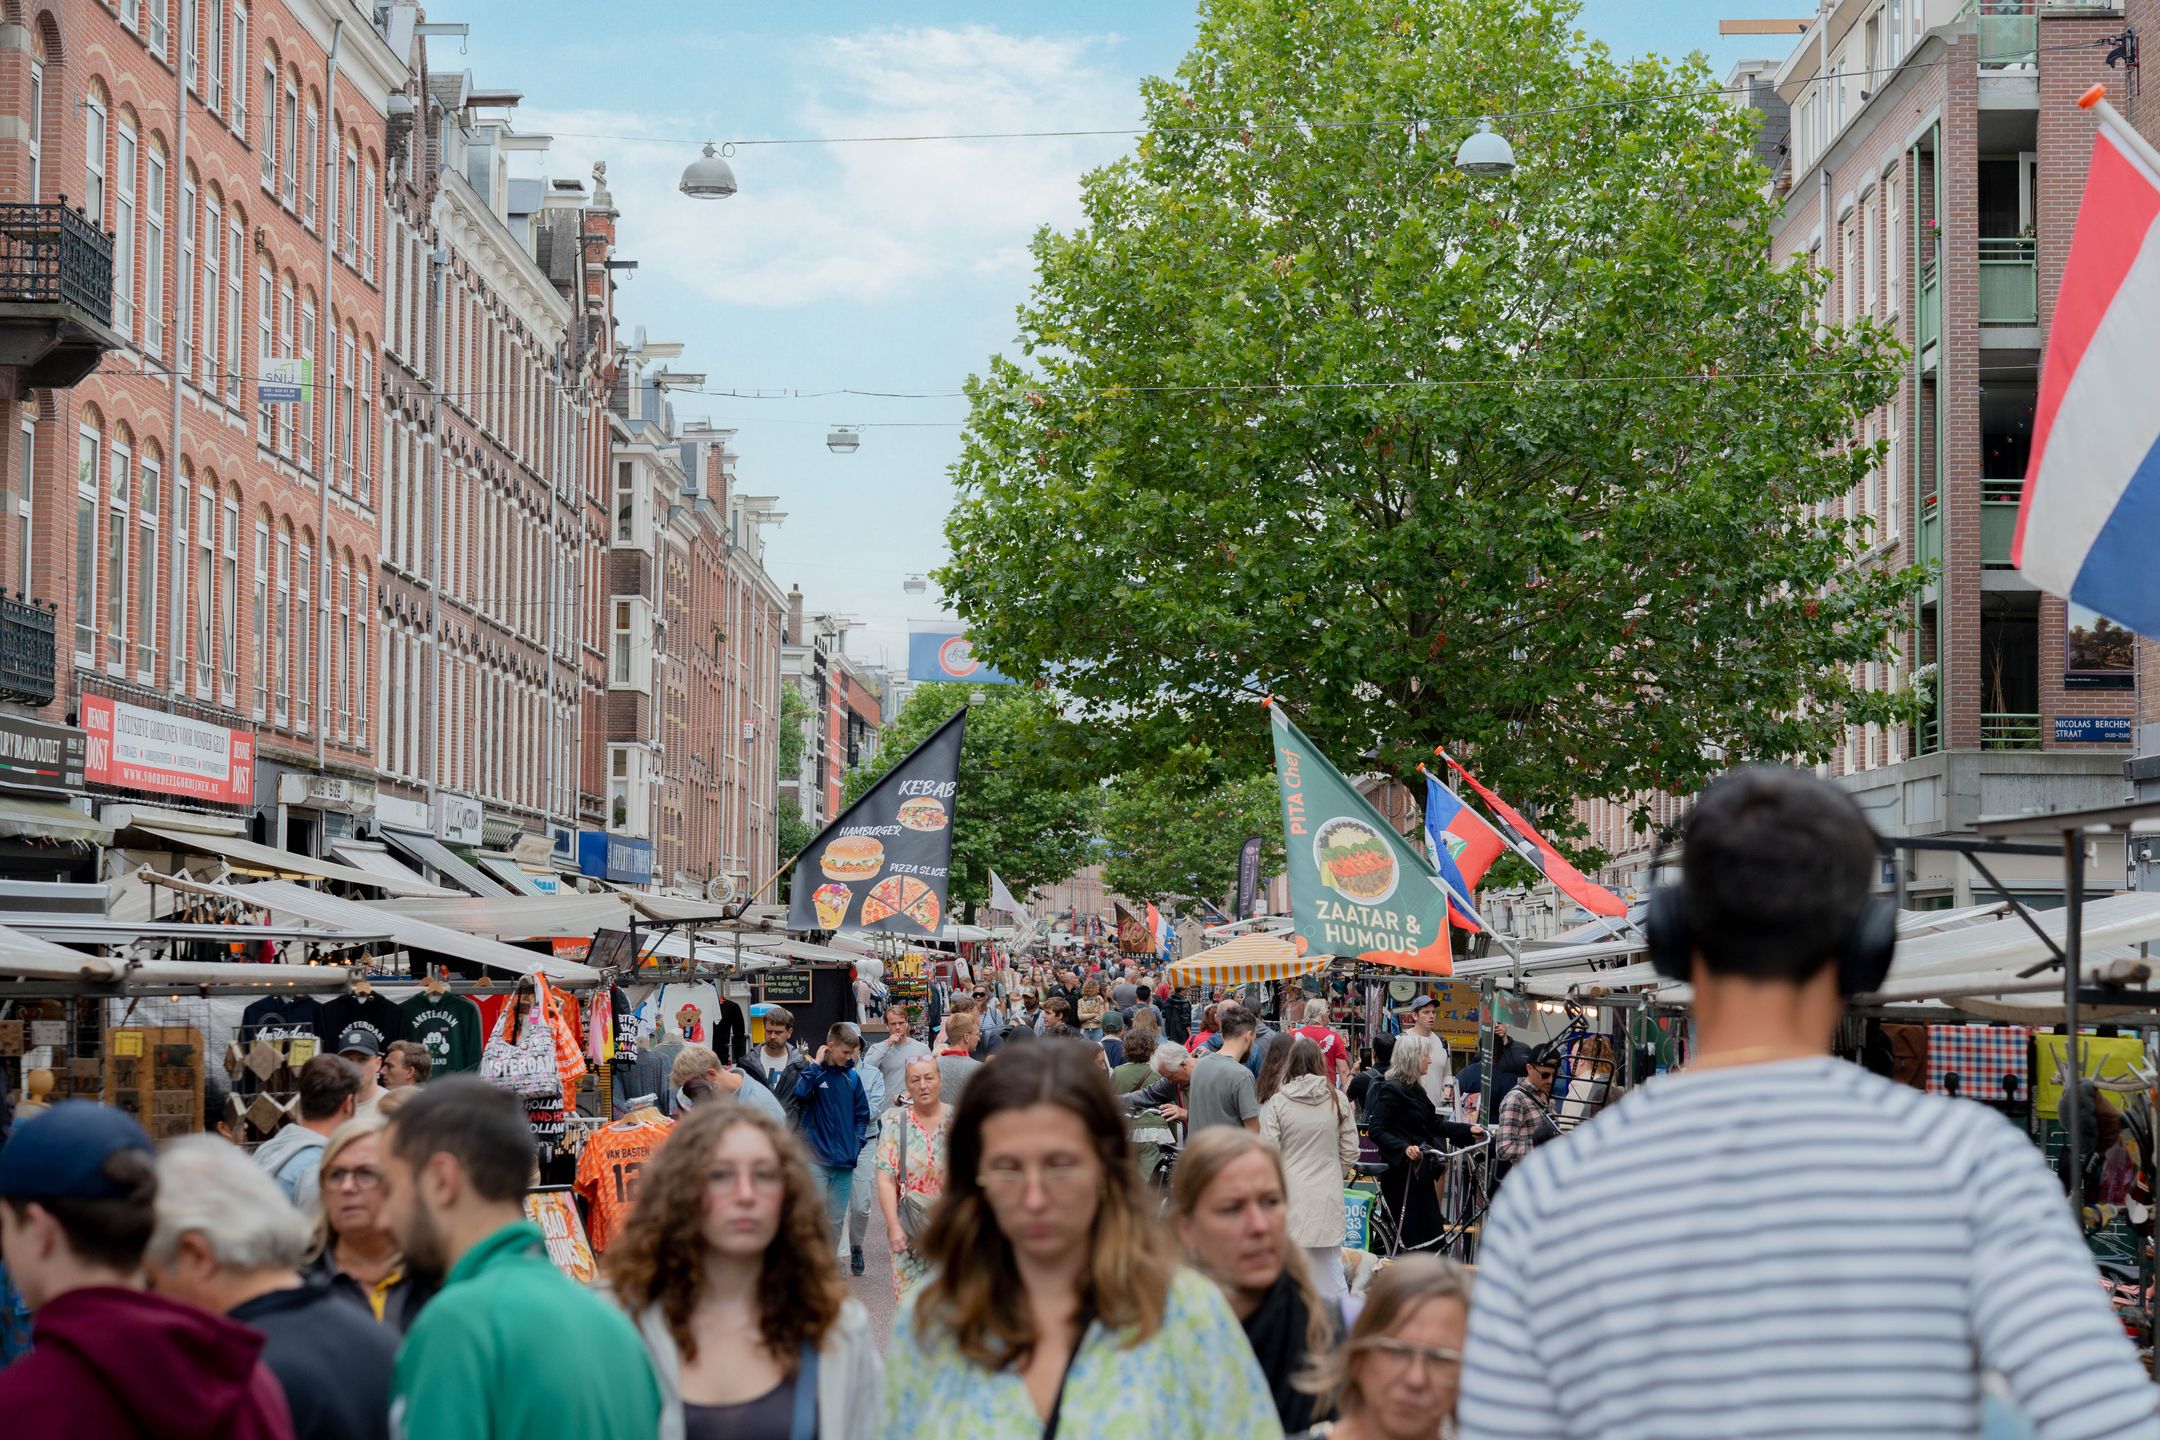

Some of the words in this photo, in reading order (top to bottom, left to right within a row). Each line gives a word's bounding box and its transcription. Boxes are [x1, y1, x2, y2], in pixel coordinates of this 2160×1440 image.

[266, 372, 294, 384] SNIJ
[87, 707, 110, 731] HENNIE
[2055, 720, 2091, 728] NICOLAAS
[2095, 720, 2131, 728] BERCHEM
[2055, 730, 2082, 738] STRAAT
[86, 736, 109, 772] DOST
[1280, 748, 1302, 790] Chef
[232, 765, 250, 794] DOST
[329, 782, 341, 798] SIZE
[898, 780, 956, 798] KEBAB
[1287, 792, 1308, 836] PITA
[840, 825, 902, 837] HAMBURGER
[890, 862, 918, 874] PIZZA
[919, 866, 948, 877] SLICE
[1316, 900, 1400, 930] ZAATAR
[1406, 915, 1422, 934] &
[1324, 923, 1419, 956] HUMOUS
[1430, 991, 1451, 1002] KIDZZ
[412, 1010, 459, 1028] AMSTERDAM
[256, 1025, 316, 1041] Amsterdam
[338, 1021, 385, 1042] MSTERDAM
[606, 1148, 620, 1159] VAN
[622, 1147, 650, 1158] BASTEN
[541, 1211, 568, 1238] BAO
[544, 1238, 582, 1266] BUNS
